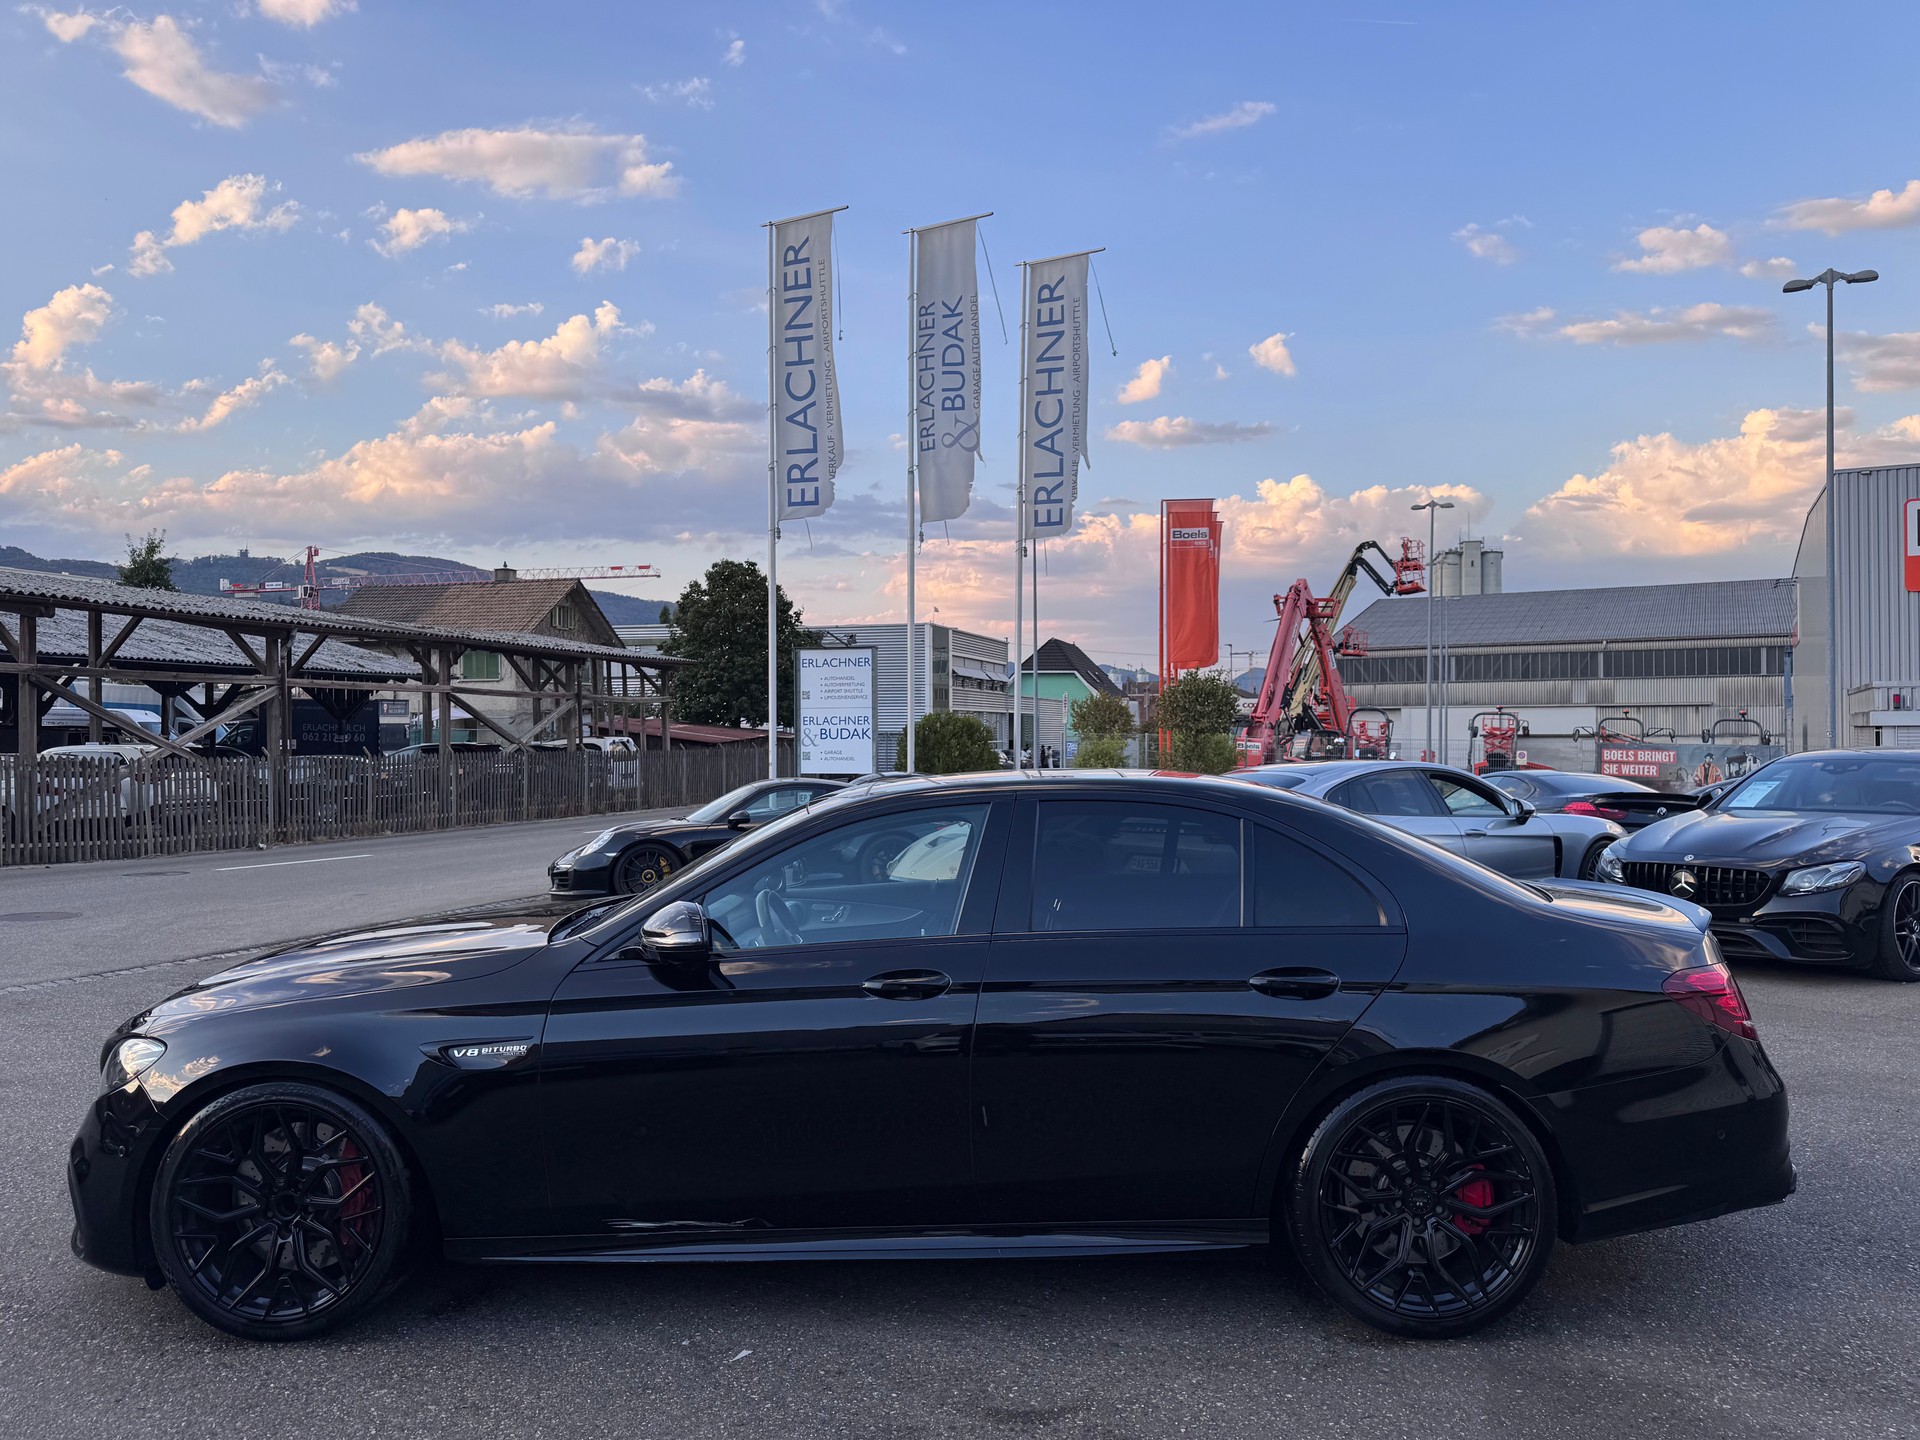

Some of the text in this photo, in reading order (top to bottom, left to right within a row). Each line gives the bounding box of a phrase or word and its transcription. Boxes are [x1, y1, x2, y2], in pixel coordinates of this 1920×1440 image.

[1072, 296, 1081, 383] AIRPORTSHUTTLE
[970, 294, 981, 410] GARAGE AUTOHANDEL
[783, 235, 820, 508] ERLACHNER
[818, 258, 837, 481] VERKAUF VERMIETUNG AIRPORTSHUTTLE
[918, 300, 936, 453] ERLACHNER
[940, 294, 980, 453] & BUDAK
[1033, 275, 1065, 528] ERLACHNER
[1072, 388, 1081, 454] VERMIETUNG
[1172, 530, 1208, 539] Boels
[801, 657, 871, 668] ERLACHNER
[302, 723, 366, 732] ERLACHR.CH
[802, 716, 871, 726] ERLACHNER
[302, 732, 320, 741] 062
[801, 728, 872, 747] & BUDAK
[1237, 742, 1260, 750] Bels
[1603, 750, 1676, 762] BOELS BRINGT
[1603, 764, 1657, 776] SIE WEITER
[453, 1045, 528, 1057] V8 BITURBO
